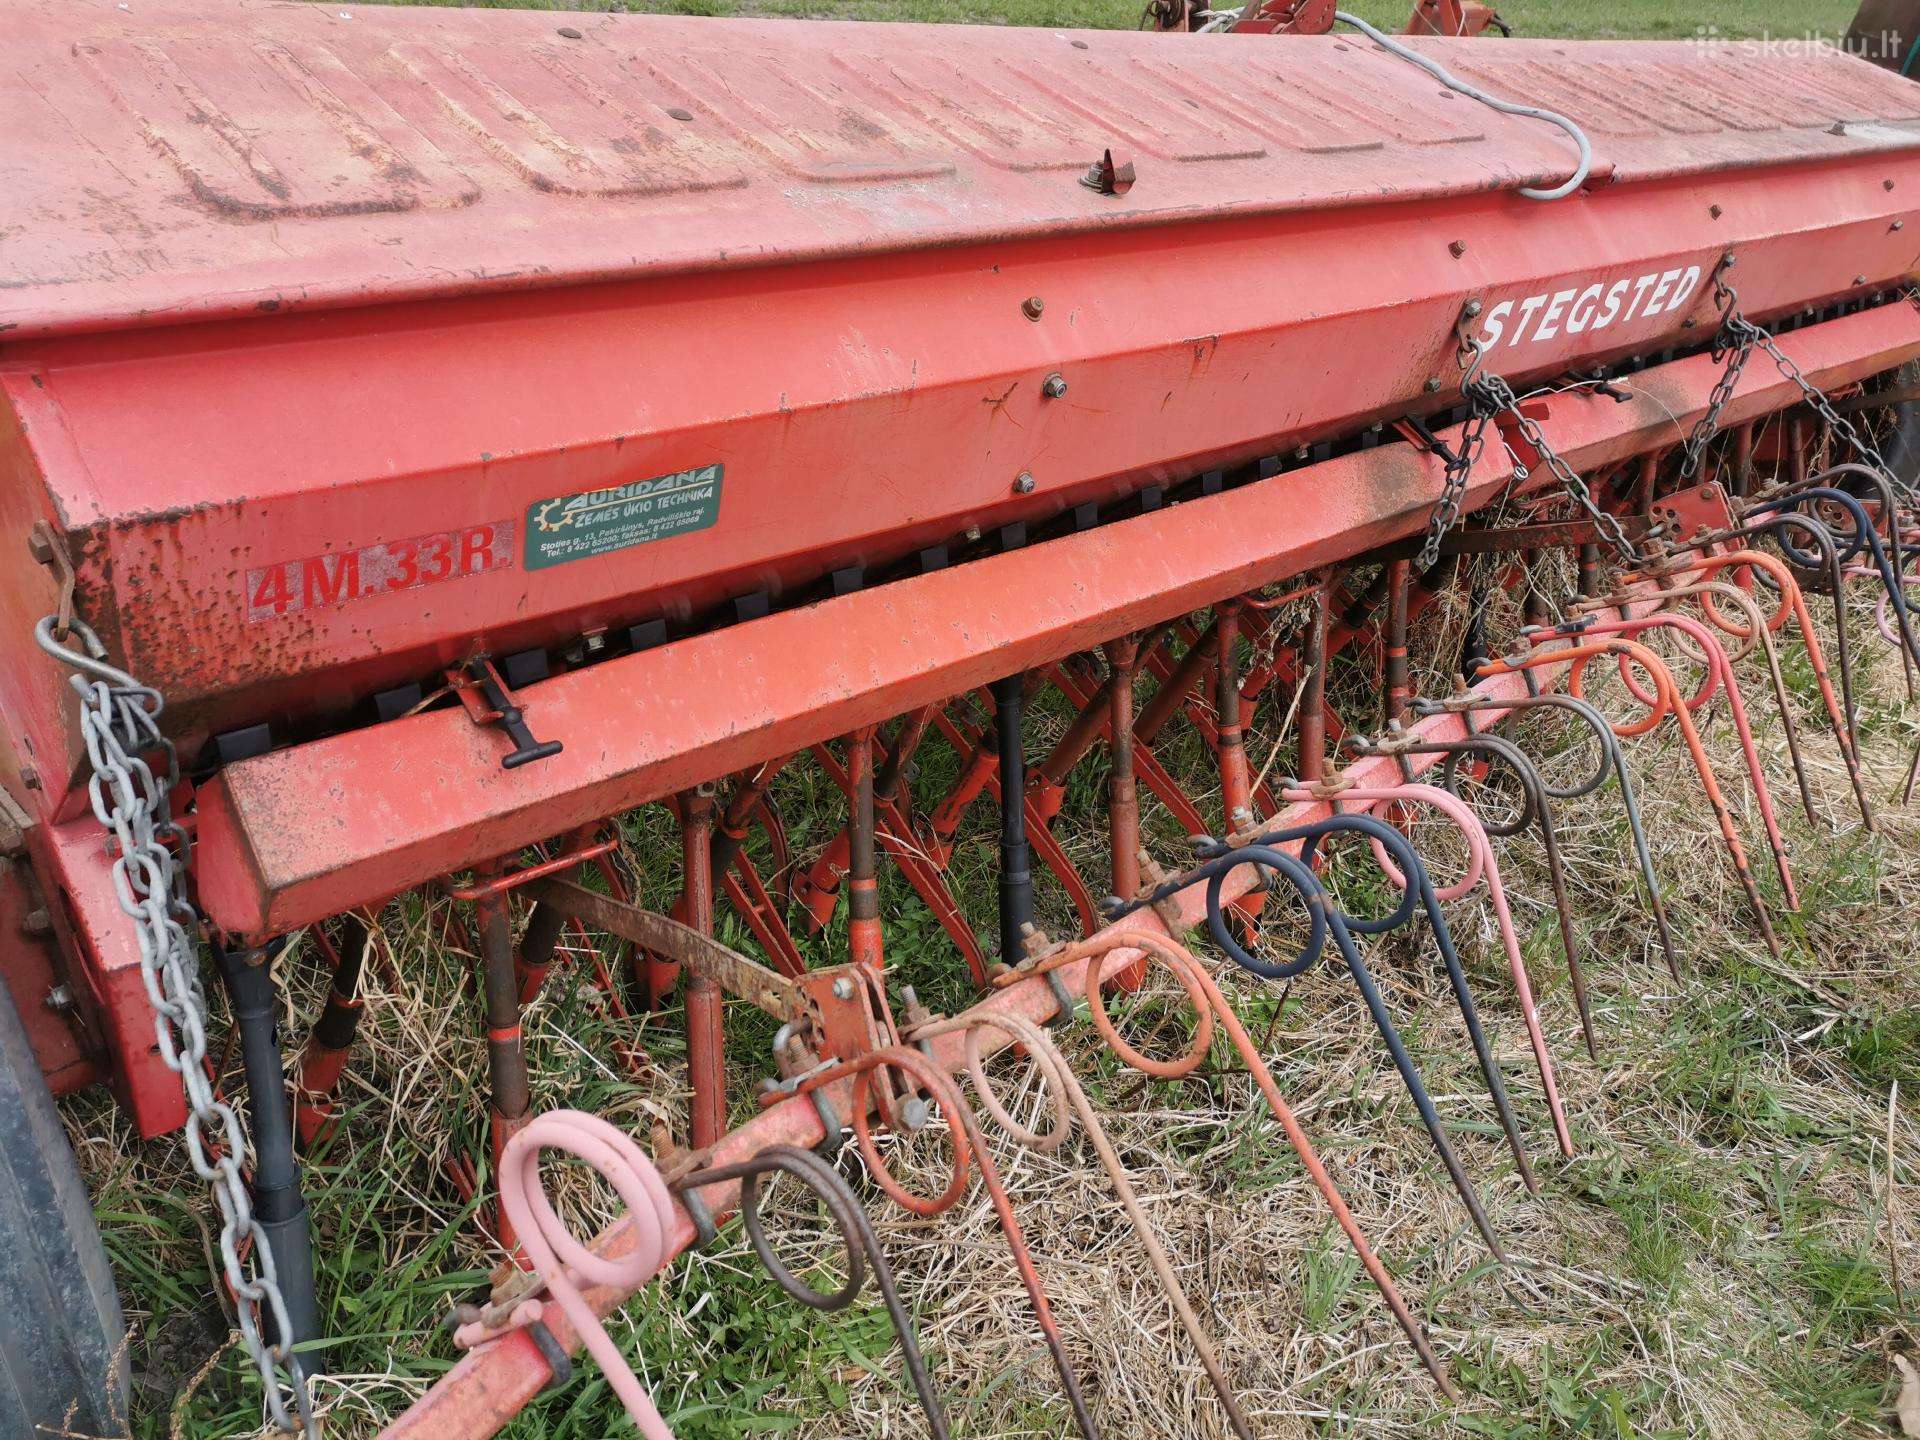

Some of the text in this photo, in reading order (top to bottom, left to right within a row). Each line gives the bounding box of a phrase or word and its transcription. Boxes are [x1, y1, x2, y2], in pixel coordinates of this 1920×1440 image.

[1468, 265, 1701, 358] STEGSTED
[565, 466, 717, 511] AURIDANA
[657, 485, 713, 509] TECHNIKA
